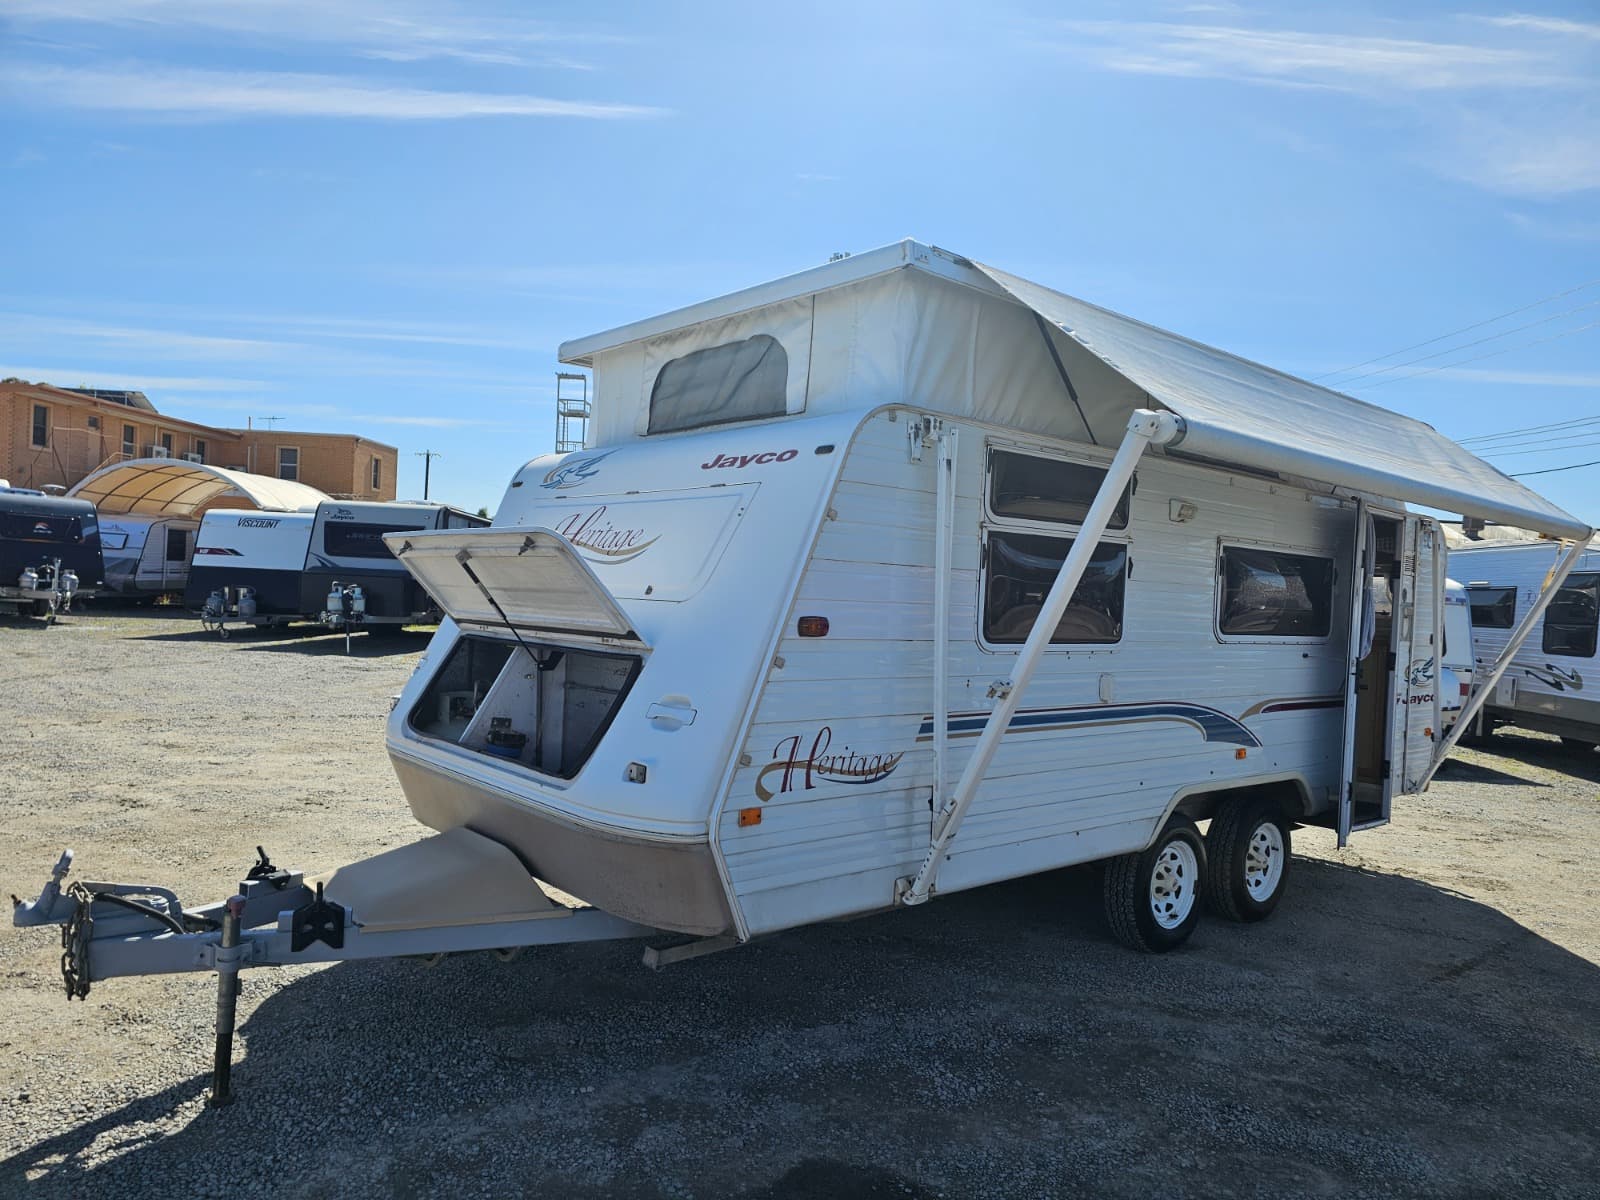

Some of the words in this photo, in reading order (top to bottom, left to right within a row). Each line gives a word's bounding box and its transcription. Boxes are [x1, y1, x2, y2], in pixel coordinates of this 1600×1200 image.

[701, 449, 799, 469] Jayco
[237, 517, 282, 528] VISCOUNT
[555, 505, 644, 556] Heritage
[772, 726, 894, 793] Heritage
